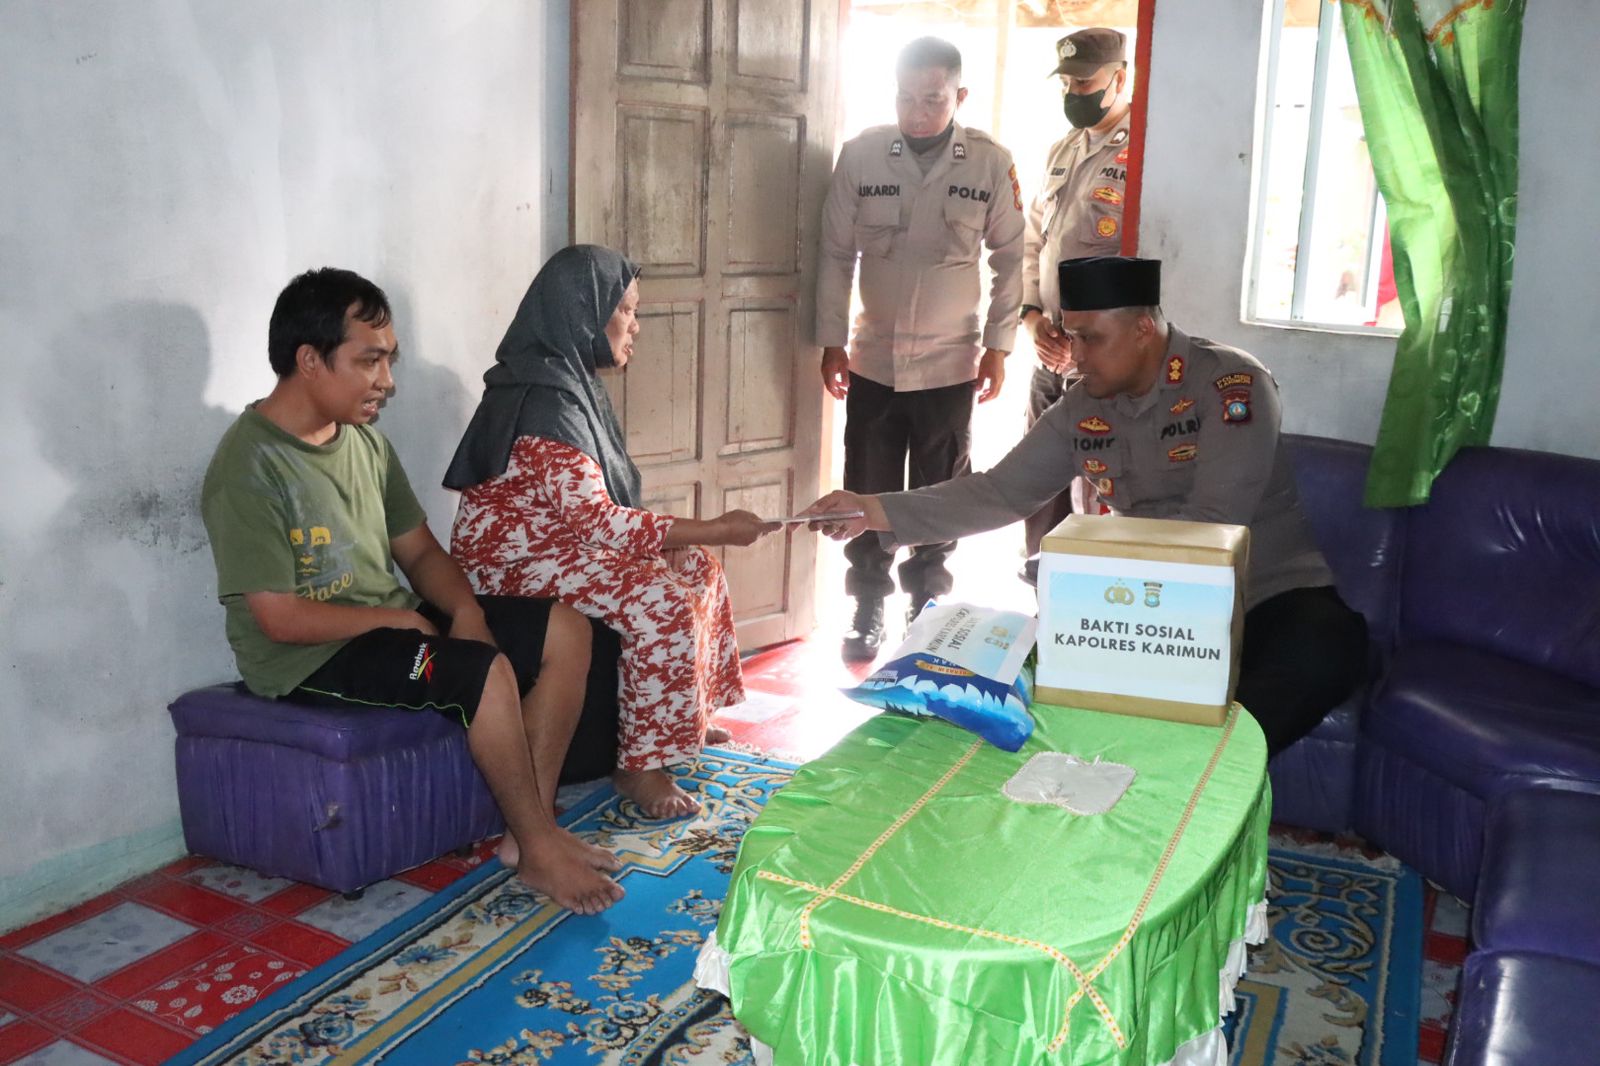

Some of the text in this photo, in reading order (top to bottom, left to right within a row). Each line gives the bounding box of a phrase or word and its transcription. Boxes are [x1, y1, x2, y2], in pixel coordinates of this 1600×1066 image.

[1099, 167, 1125, 181] POLR
[949, 185, 991, 203] POLRI
[1080, 618, 1195, 641] BAKTI SOSIAL
[1054, 633, 1221, 660] KAPOLRES KARIMUN
